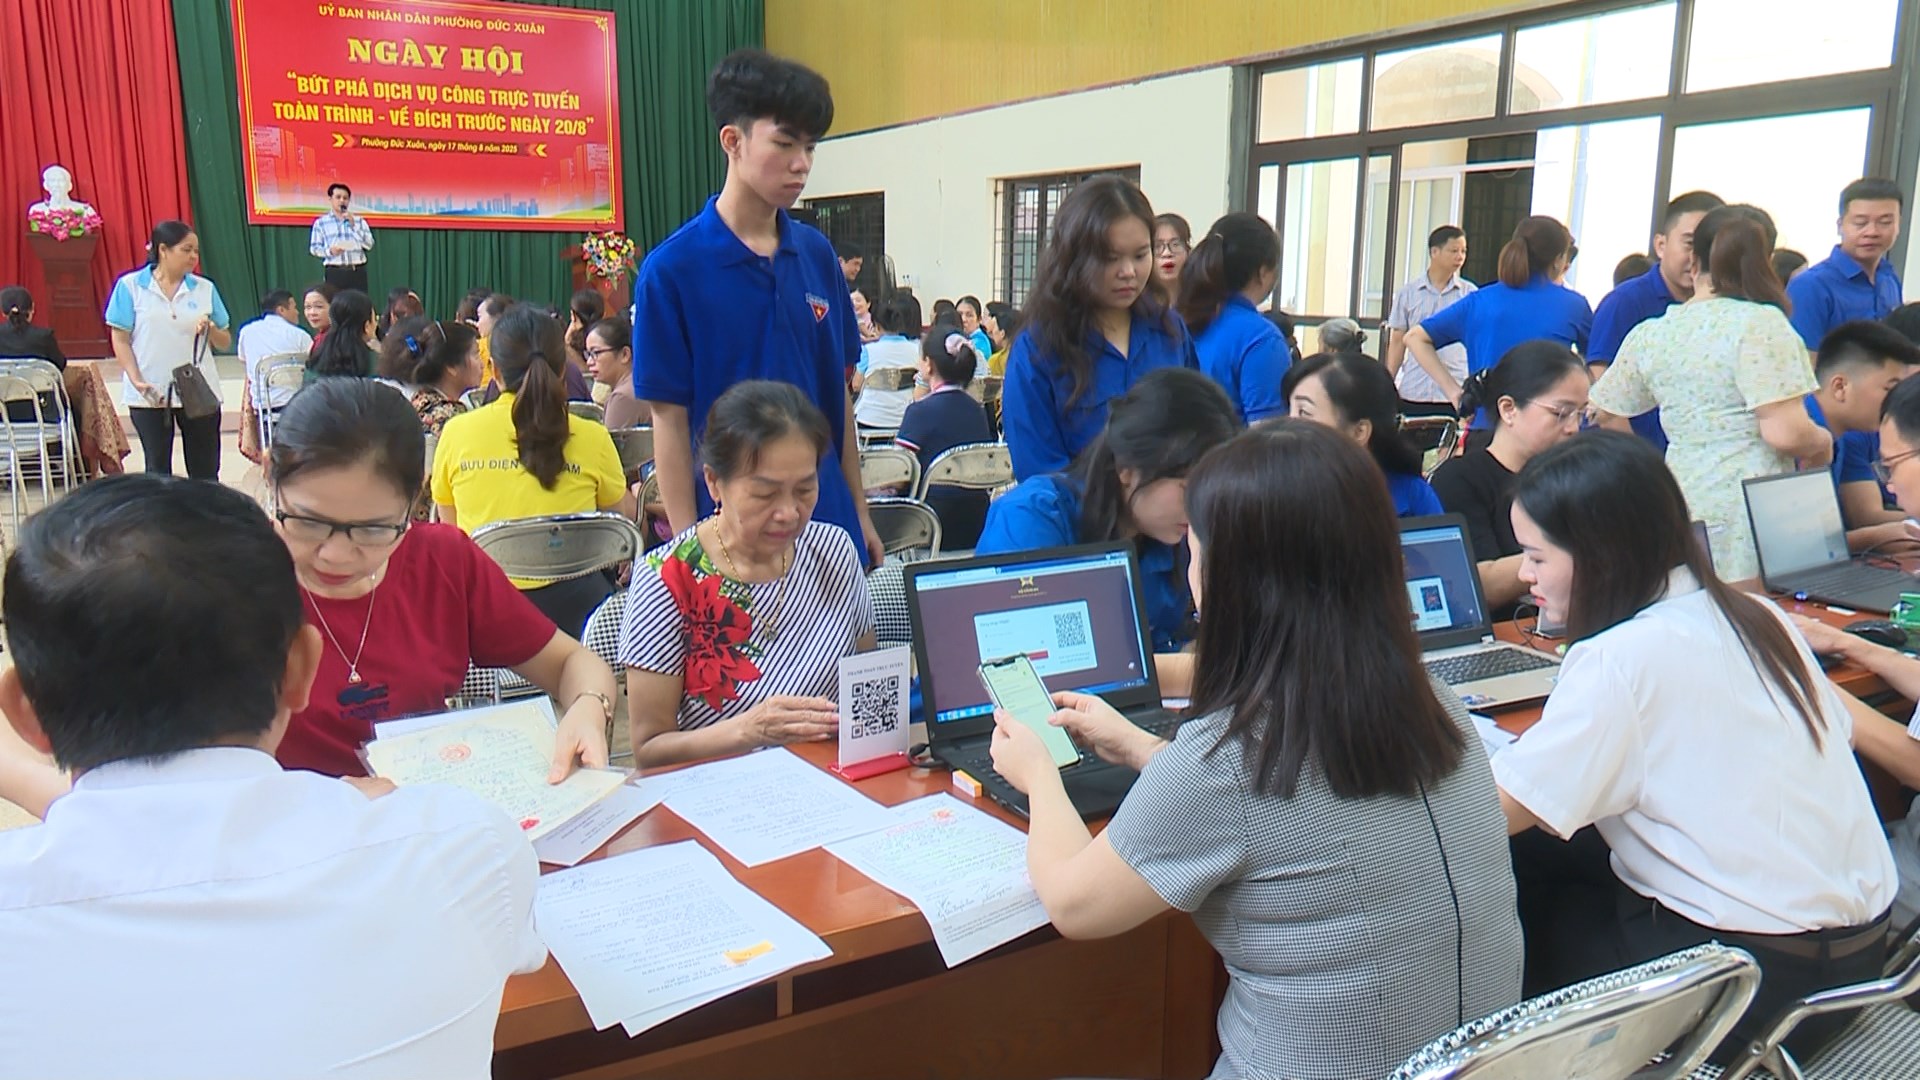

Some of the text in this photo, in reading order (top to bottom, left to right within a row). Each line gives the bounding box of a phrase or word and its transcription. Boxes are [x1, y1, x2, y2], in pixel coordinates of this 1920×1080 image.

[338, 8, 364, 19] BAN
[367, 10, 402, 22] NHÂN
[405, 12, 430, 25] DÂN
[434, 15, 483, 30] PHƯỜNG
[486, 19, 511, 32] ĐỨC
[514, 22, 545, 34] XUÂN
[347, 37, 524, 77] NGÀY HỘI
[334, 77, 369, 97] PHÁ
[373, 81, 412, 102] DỊCH
[416, 84, 437, 105] VỤ
[442, 84, 485, 104] CÔNG
[489, 89, 529, 110] TRỰC
[532, 89, 580, 110] TUYẾN
[273, 101, 319, 121] TOÀN
[323, 103, 374, 124] TRÌNH
[414, 107, 452, 129] ĐÍCH
[456, 112, 506, 132] TRƯỚC
[511, 115, 551, 134] NGÀY
[361, 137, 389, 150] Phường
[390, 139, 405, 148] Đức
[428, 142, 446, 152] ngày
[448, 142, 456, 150] 17
[457, 142, 477, 153] tháng
[485, 143, 500, 152] năm
[501, 145, 518, 153] 2025
[460, 459, 581, 475] BƯU ĐIỆN AM
